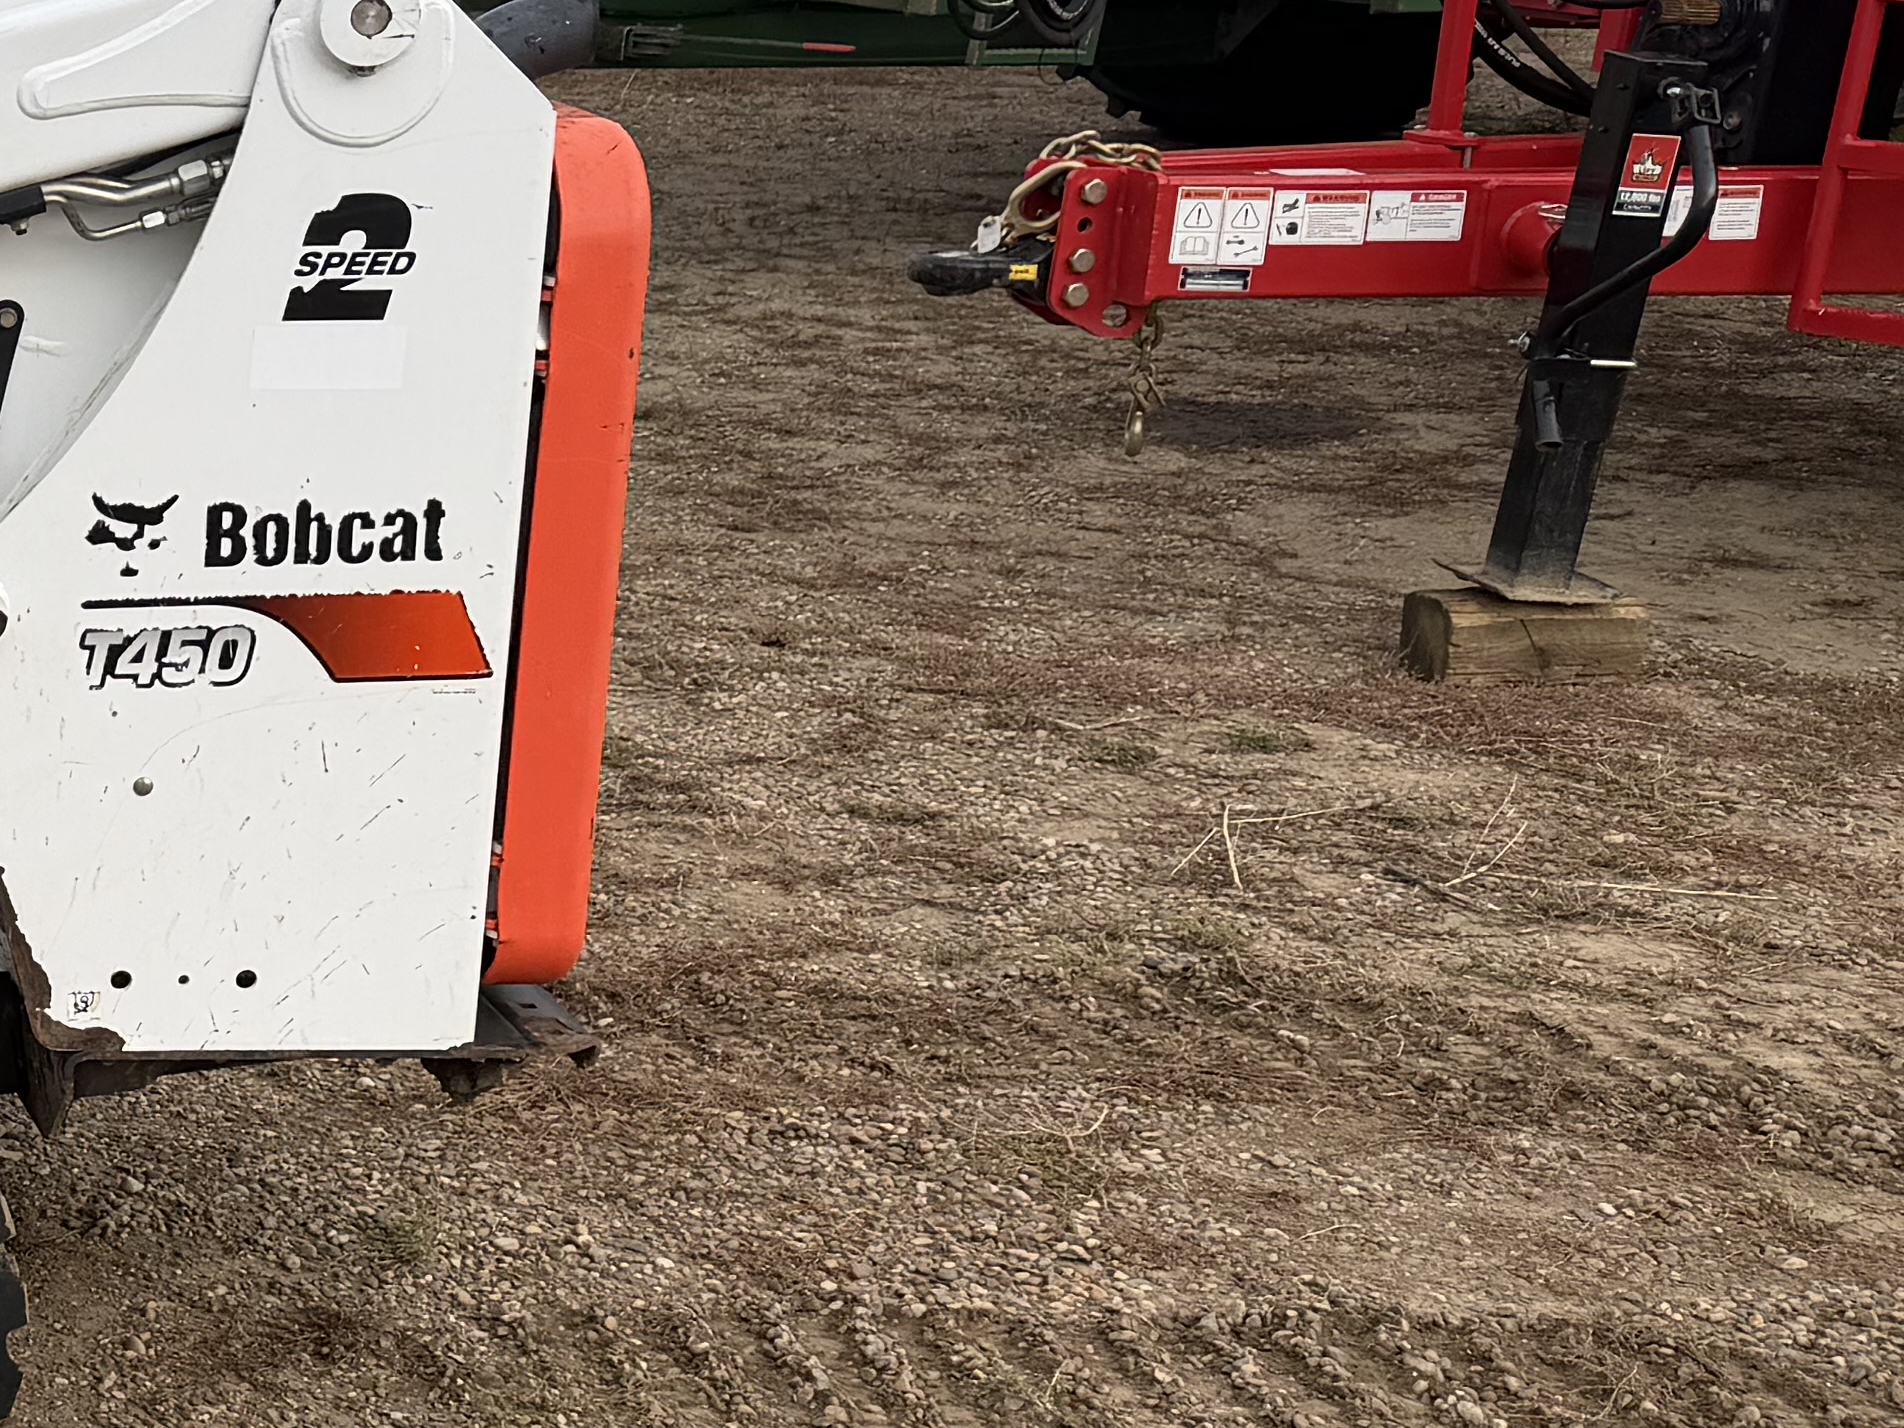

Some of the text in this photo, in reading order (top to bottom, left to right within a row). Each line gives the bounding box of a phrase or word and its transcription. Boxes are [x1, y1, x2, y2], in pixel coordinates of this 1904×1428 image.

[293, 251, 417, 277] SPEED
[204, 497, 447, 568] Bobcat
[79, 624, 257, 690] T450
